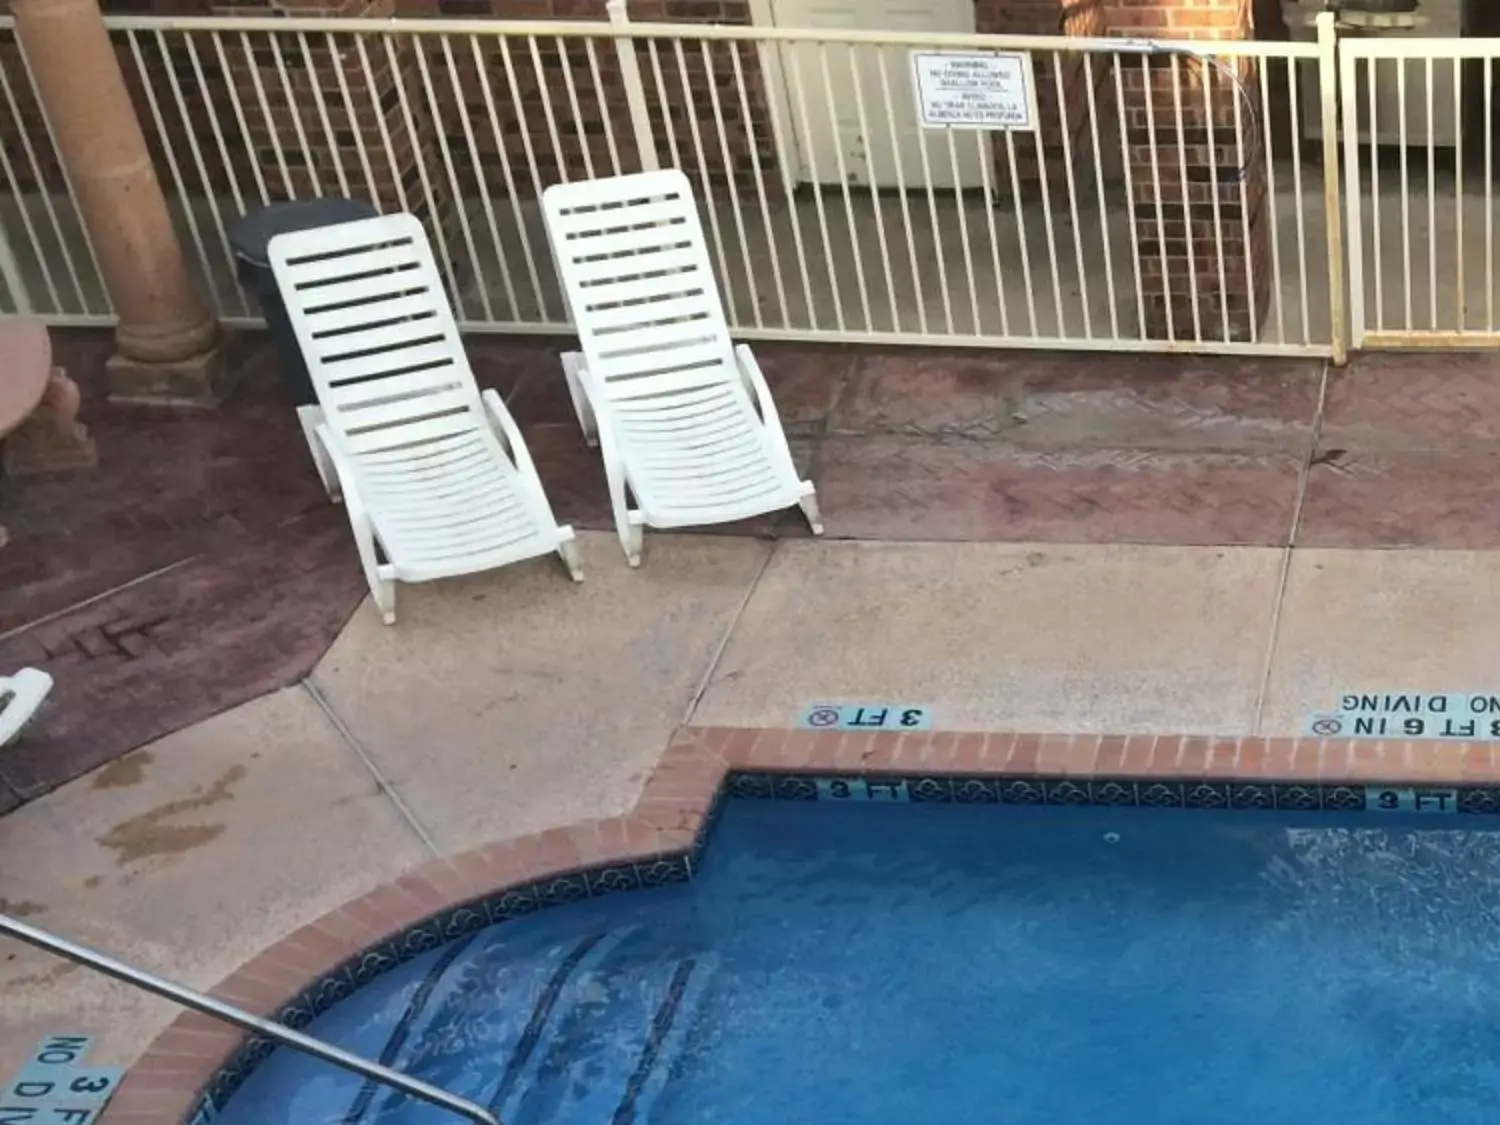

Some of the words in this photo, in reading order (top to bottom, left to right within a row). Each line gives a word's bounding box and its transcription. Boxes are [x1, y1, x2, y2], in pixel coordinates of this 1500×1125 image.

[1343, 695, 1447, 713] DIVING
[848, 708, 888, 726] FT
[900, 708, 922, 726] 3
[1354, 718, 1387, 735] IN
[1404, 718, 1425, 736] 6
[1440, 719, 1475, 737] FT
[830, 780, 852, 798] 3
[866, 781, 902, 799] FT
[1415, 791, 1452, 811] FT
[37, 1036, 88, 1065] NO
[70, 1077, 110, 1093] 3
